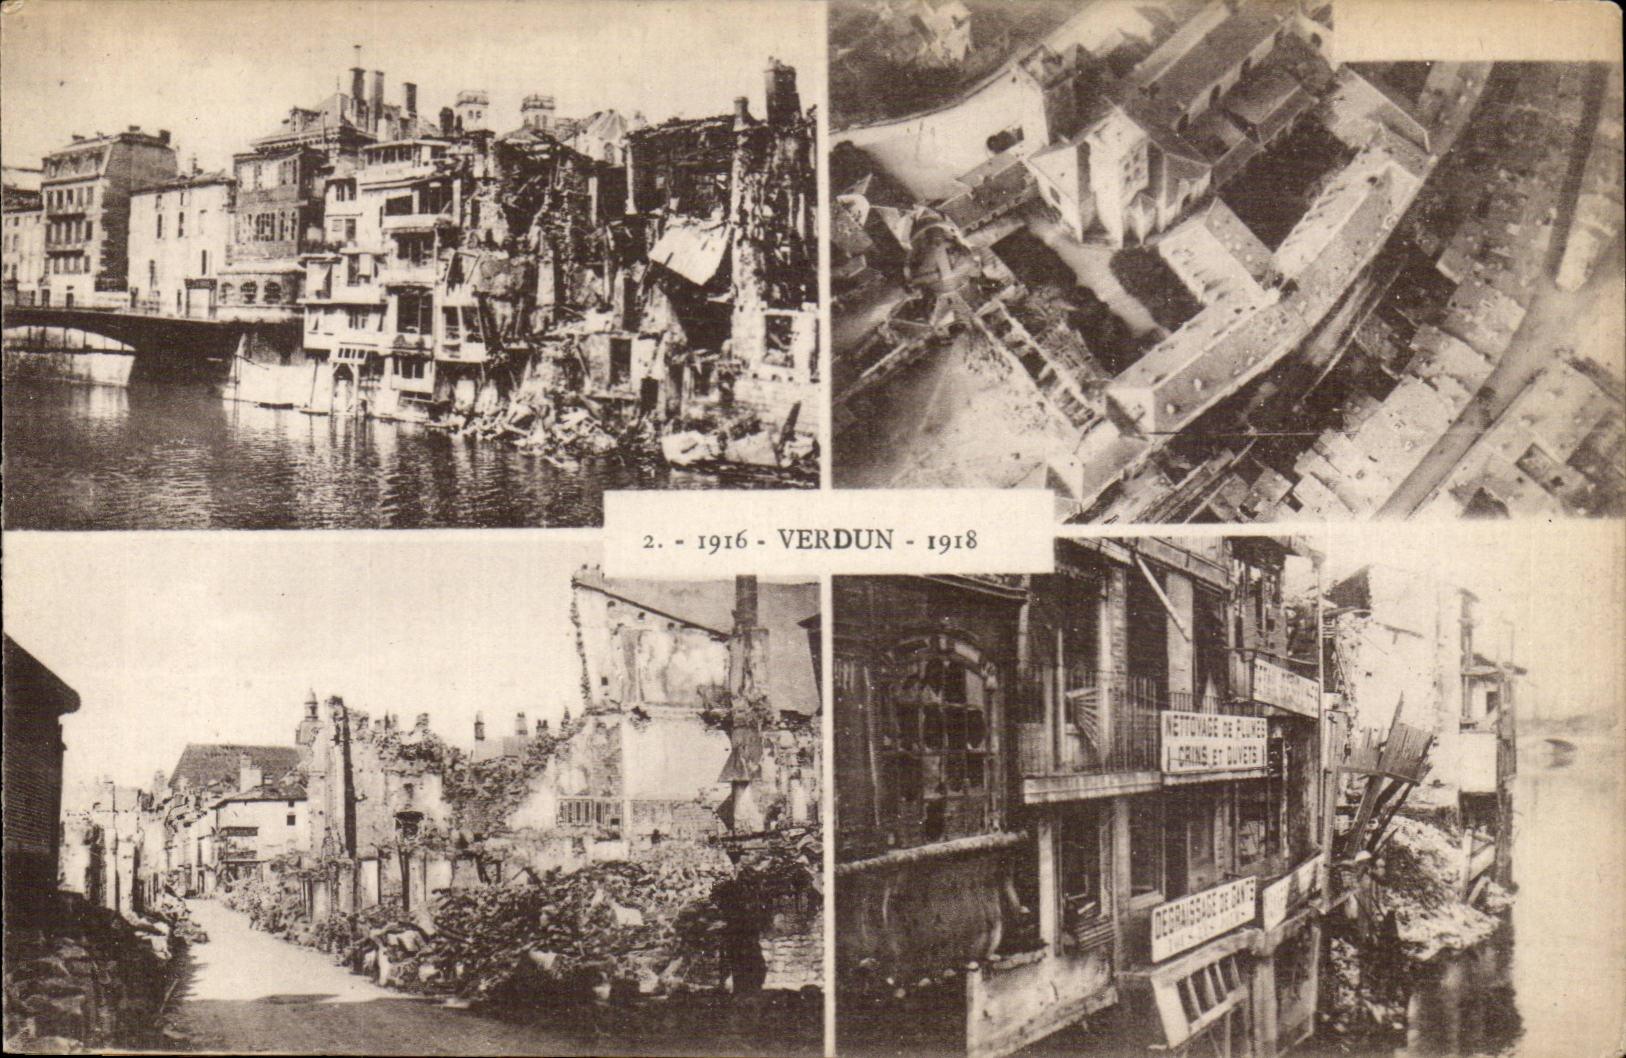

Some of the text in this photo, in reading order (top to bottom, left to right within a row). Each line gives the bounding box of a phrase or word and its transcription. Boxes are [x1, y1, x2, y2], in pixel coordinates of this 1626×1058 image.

[1165, 714, 1265, 739] NETTOYAGE DE PLUMES
[1178, 745, 1257, 767] CRINS ET DUVETS
[1220, 892, 1230, 914] DE
